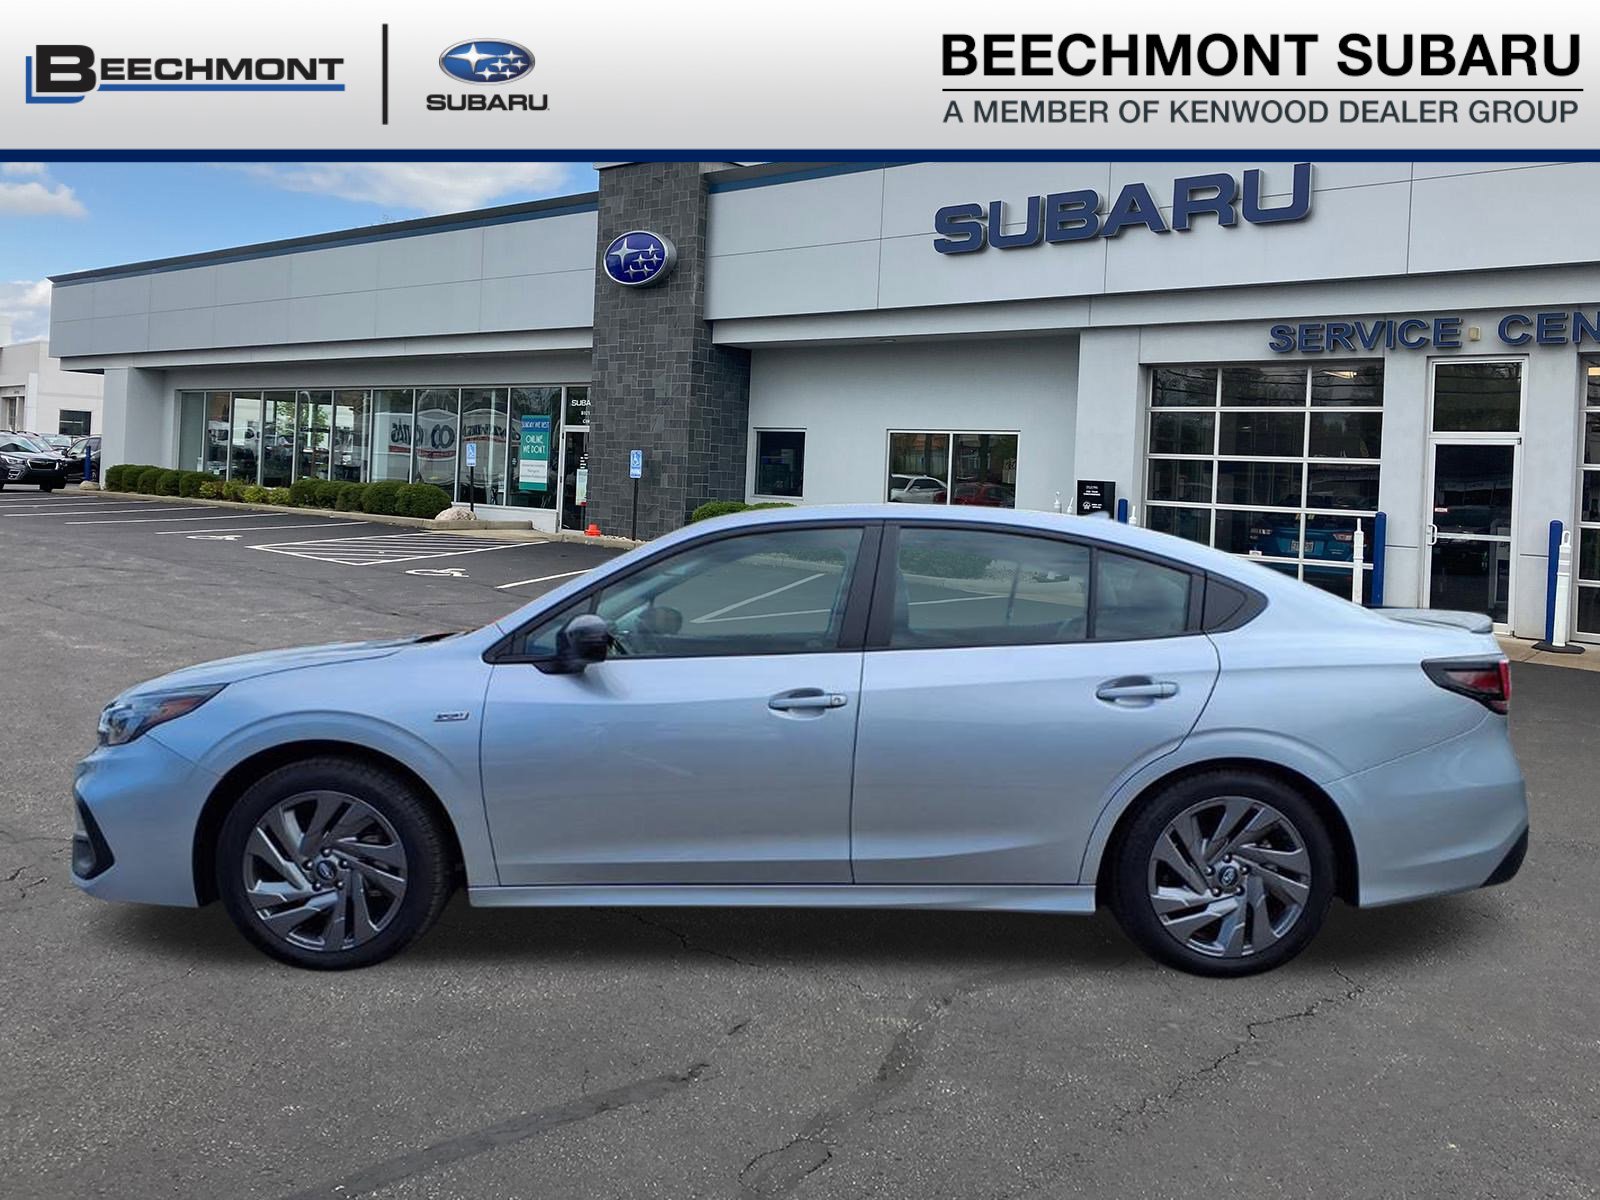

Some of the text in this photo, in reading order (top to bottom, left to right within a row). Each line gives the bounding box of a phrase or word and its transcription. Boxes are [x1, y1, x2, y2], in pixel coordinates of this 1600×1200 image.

[934, 162, 1312, 254] SUBARU
[1269, 312, 1600, 352] SERVICE CEN
